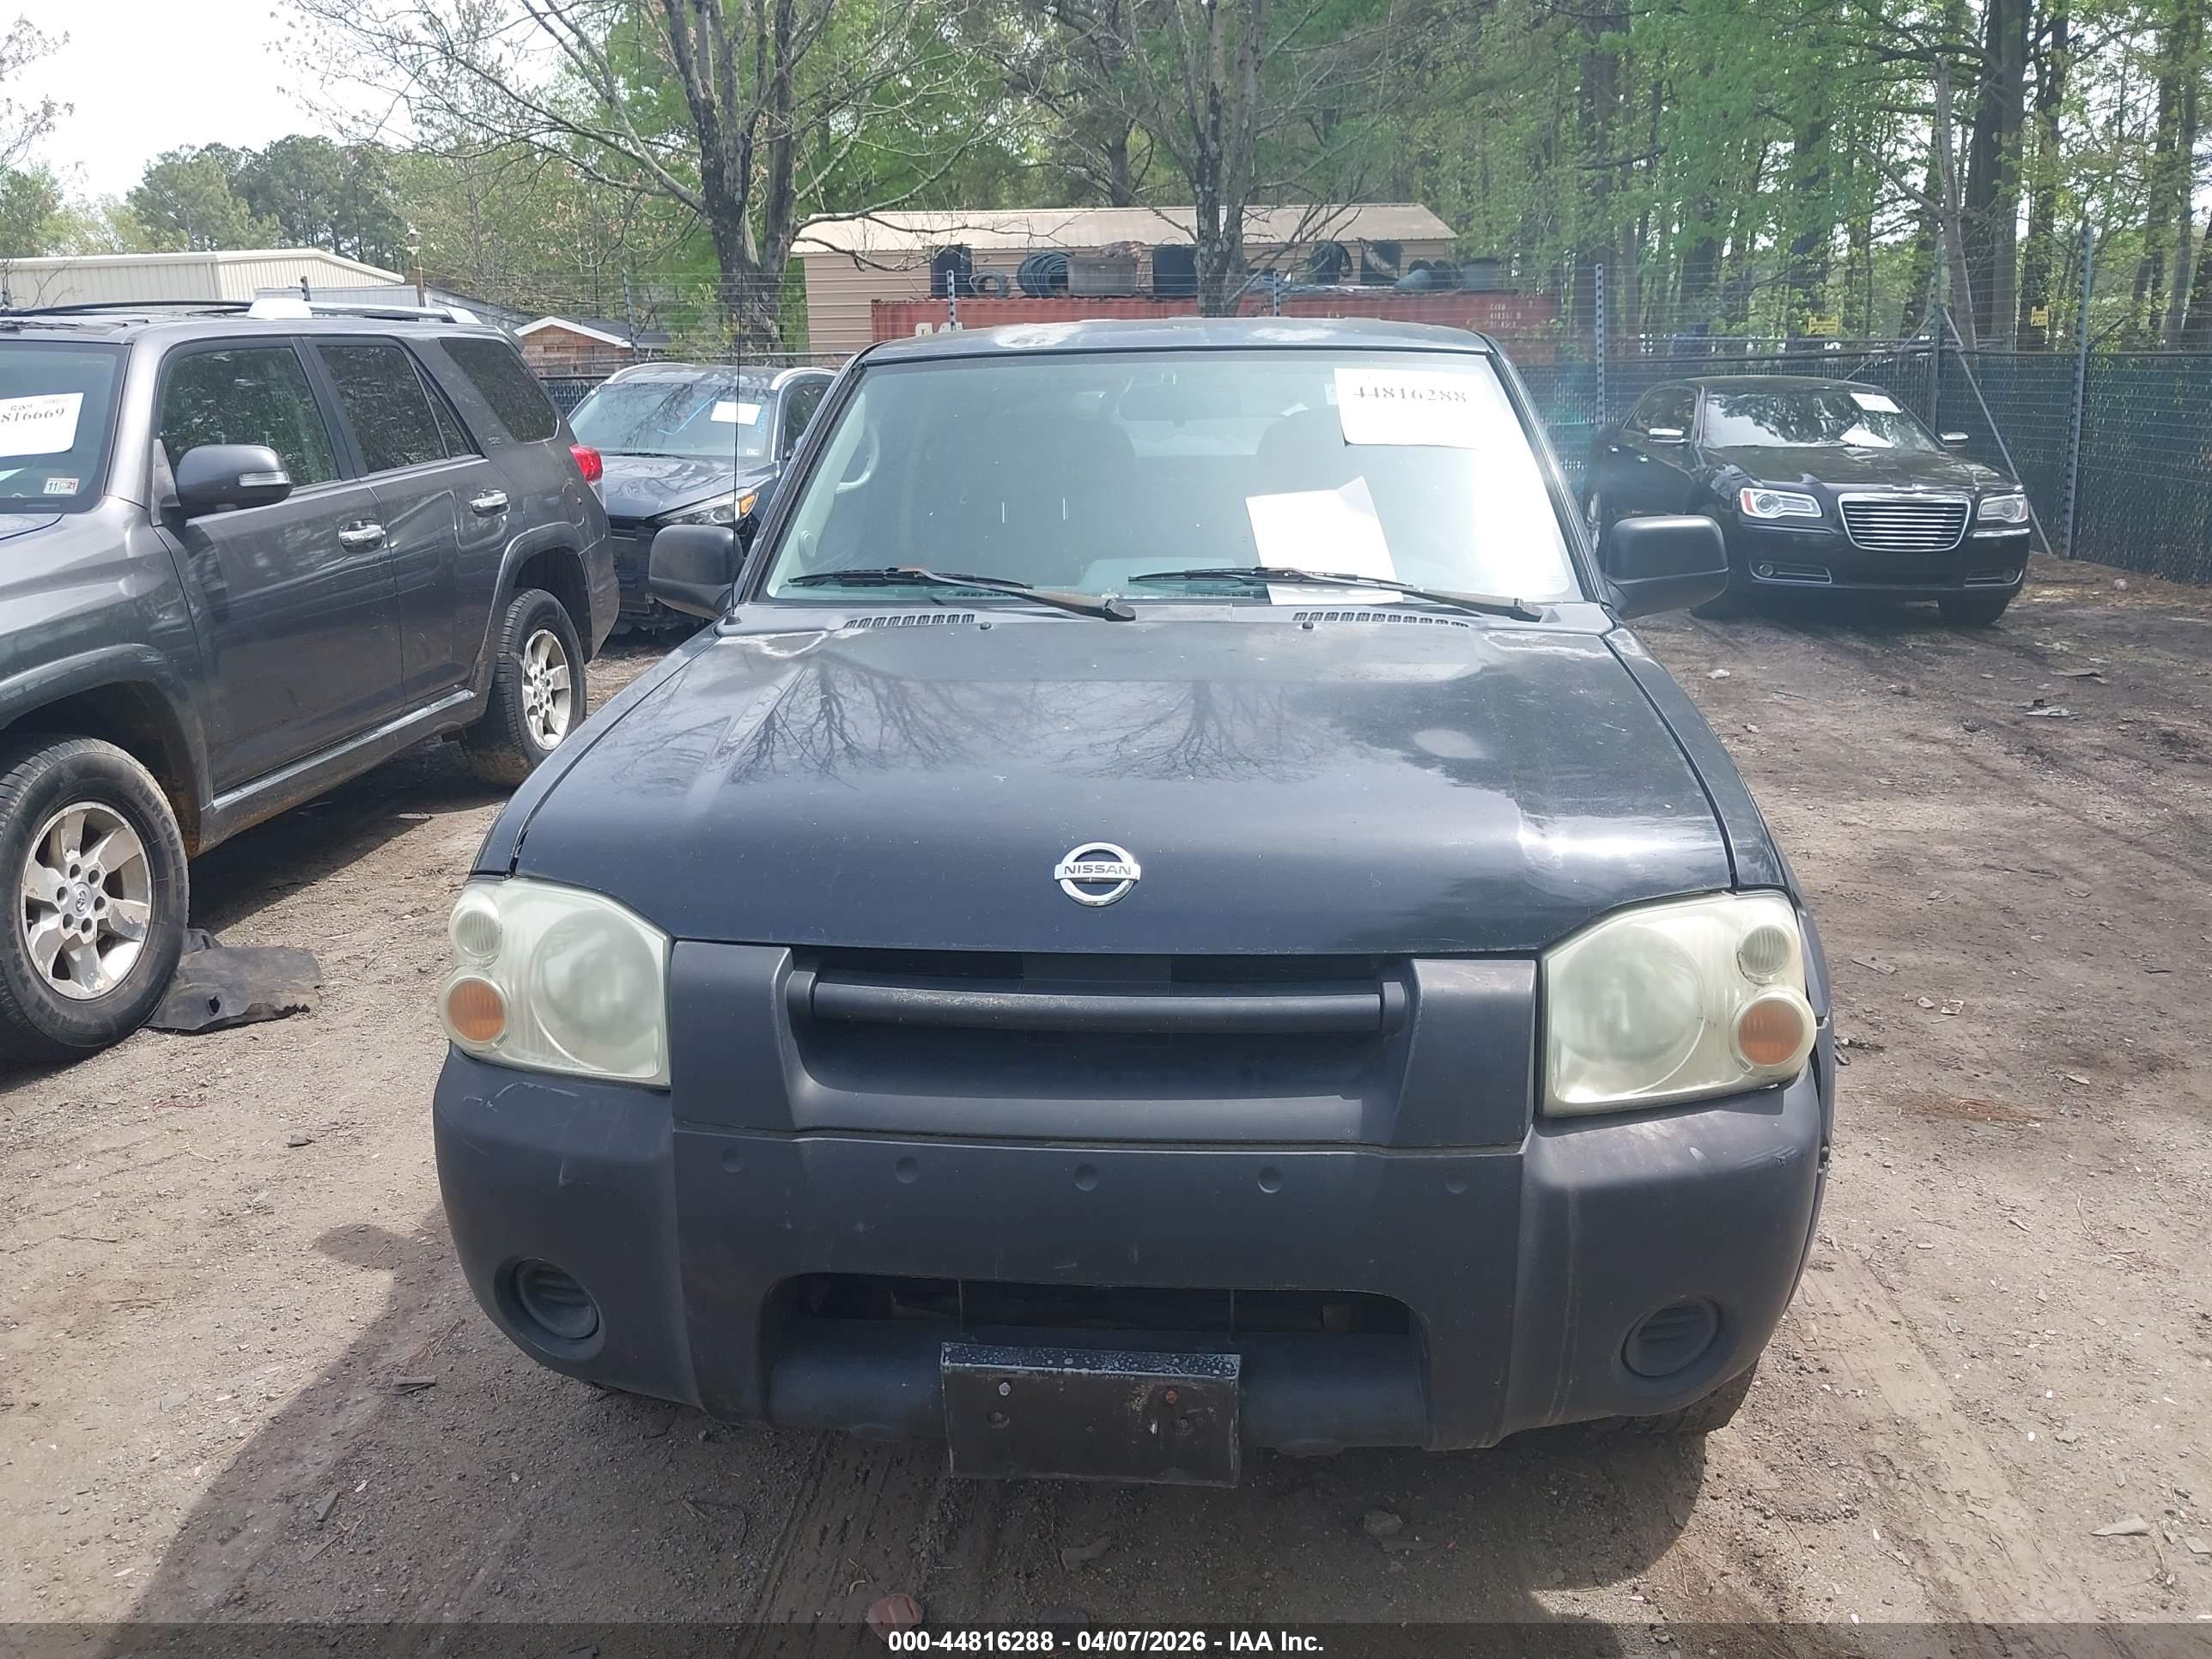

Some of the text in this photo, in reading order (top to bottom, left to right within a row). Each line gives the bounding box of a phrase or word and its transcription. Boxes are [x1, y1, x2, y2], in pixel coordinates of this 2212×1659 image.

[1352, 386, 1467, 403] 44816288
[131, 779, 185, 901] HERCULES
[1064, 865, 1131, 875] NISSAN
